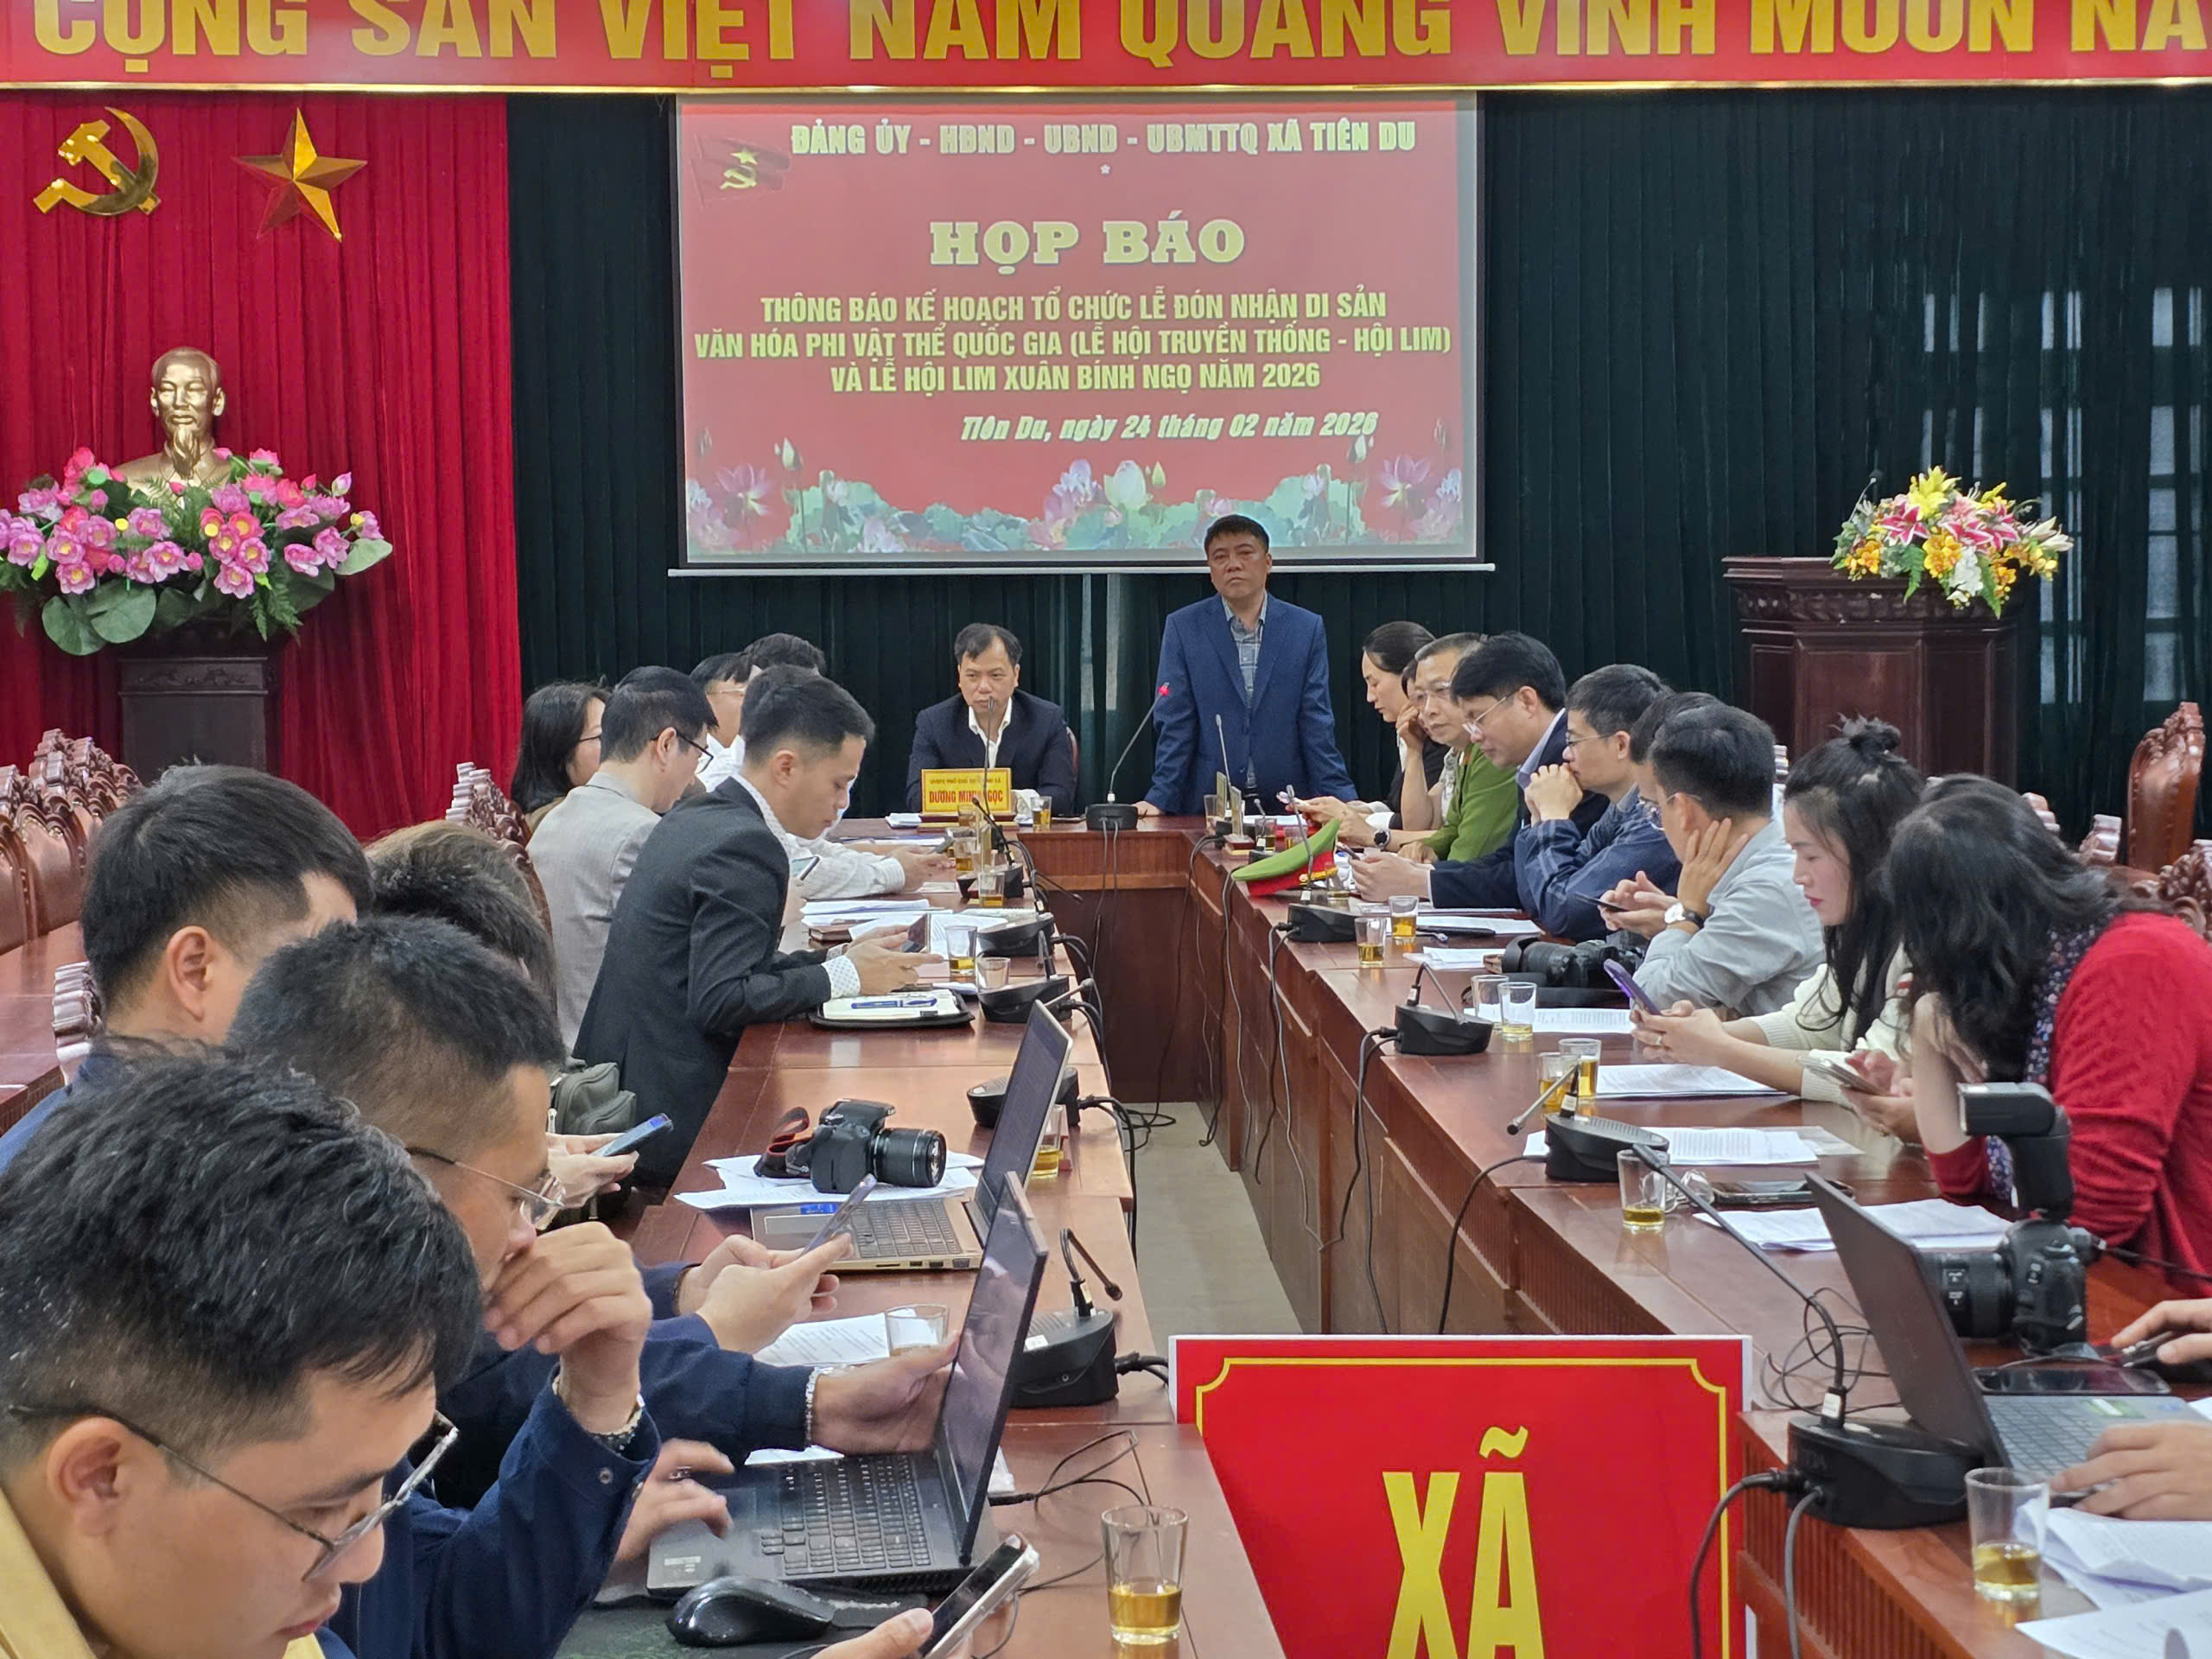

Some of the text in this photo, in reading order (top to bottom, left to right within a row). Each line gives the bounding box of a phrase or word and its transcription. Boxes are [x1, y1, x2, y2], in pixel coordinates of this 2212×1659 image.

[849, 0, 1082, 60] NAM
[1119, 0, 1452, 68] QUANG
[1496, 0, 1716, 55] VINH
[2070, 0, 2212, 52] NA
[791, 118, 866, 155] ĐẢNG
[875, 118, 912, 155] ỦY
[1044, 124, 1117, 153] UBND
[1147, 123, 1258, 155] UBMTTQ
[1267, 118, 1302, 151] XÃ
[1310, 117, 1370, 151] TIÊN
[1378, 121, 1416, 150] DU
[929, 210, 1246, 275] HỌP BÁO
[760, 284, 1388, 327] THÔNG BÁO KẾ HOẠCH TỔ CHỨC LỄ ĐÓN NHẬN DI SẢN
[694, 328, 743, 358] VĂN
[750, 327, 799, 358] HÓA
[805, 333, 846, 358] PHI
[852, 327, 896, 363] VẬT
[902, 322, 947, 357] THỂ
[952, 323, 1015, 359] QUỐC
[1023, 331, 1063, 356] GIA
[1070, 321, 1106, 358] (LỄ
[1112, 326, 1152, 359] HỘI
[1159, 321, 1247, 354] TRUYỀN
[1254, 320, 1331, 353] THỐNG
[1354, 322, 1394, 357] HỘI
[1400, 327, 1452, 353] LIM)
[830, 358, 1320, 397] VÀ LỄ HỘI LIM XUÂN BÍNH NGỌ NĂM 2026
[1058, 414, 1118, 442] ngày
[1120, 414, 1151, 438] 24
[1157, 413, 1224, 440] tháng
[1228, 413, 1260, 437] 02
[1262, 411, 1315, 436] năm
[1319, 411, 1379, 436] 2026
[1382, 1425, 1546, 1659] XÃ
